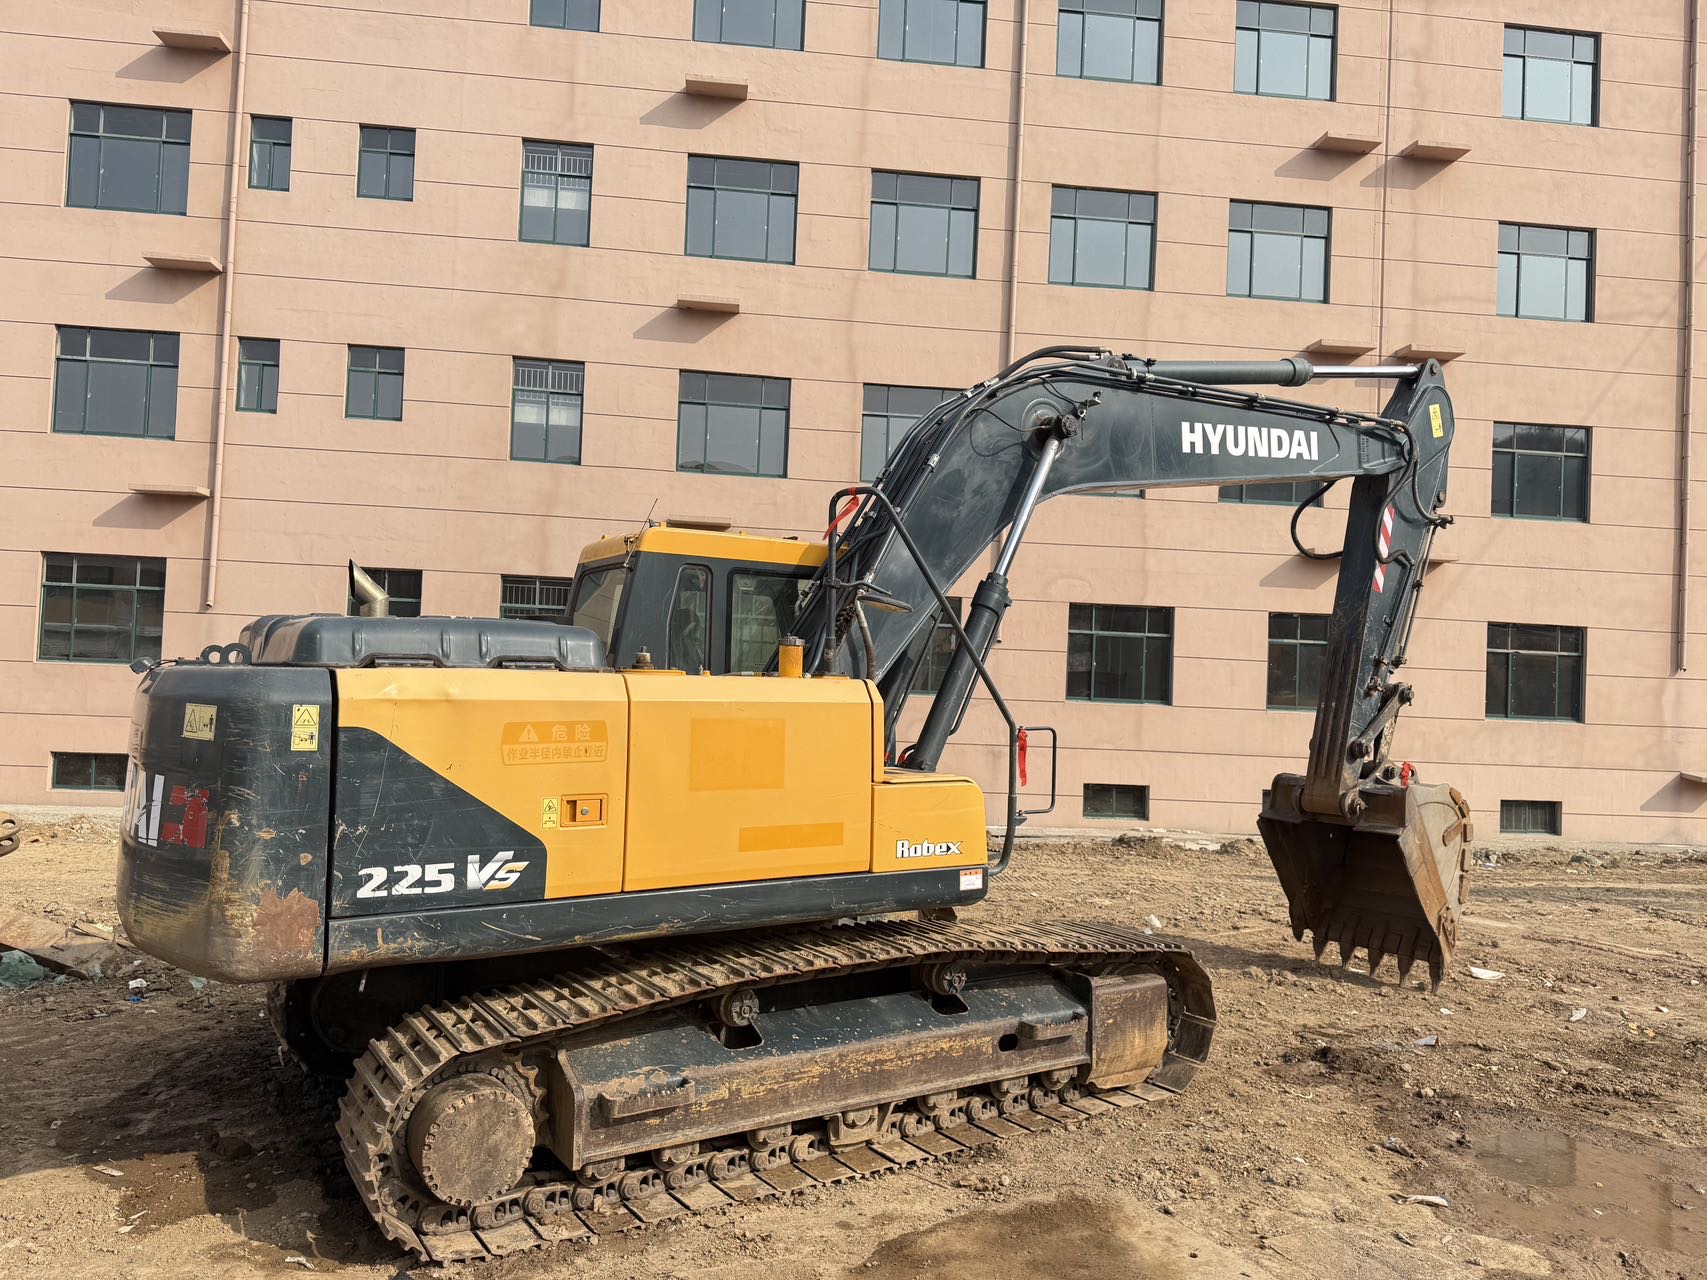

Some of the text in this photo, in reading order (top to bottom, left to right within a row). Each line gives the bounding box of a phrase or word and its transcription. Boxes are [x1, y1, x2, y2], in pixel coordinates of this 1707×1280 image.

[1181, 421, 1318, 460] HYUNDAI
[551, 723, 592, 741] 危险
[896, 838, 963, 858] Robex
[356, 863, 455, 898] 225
